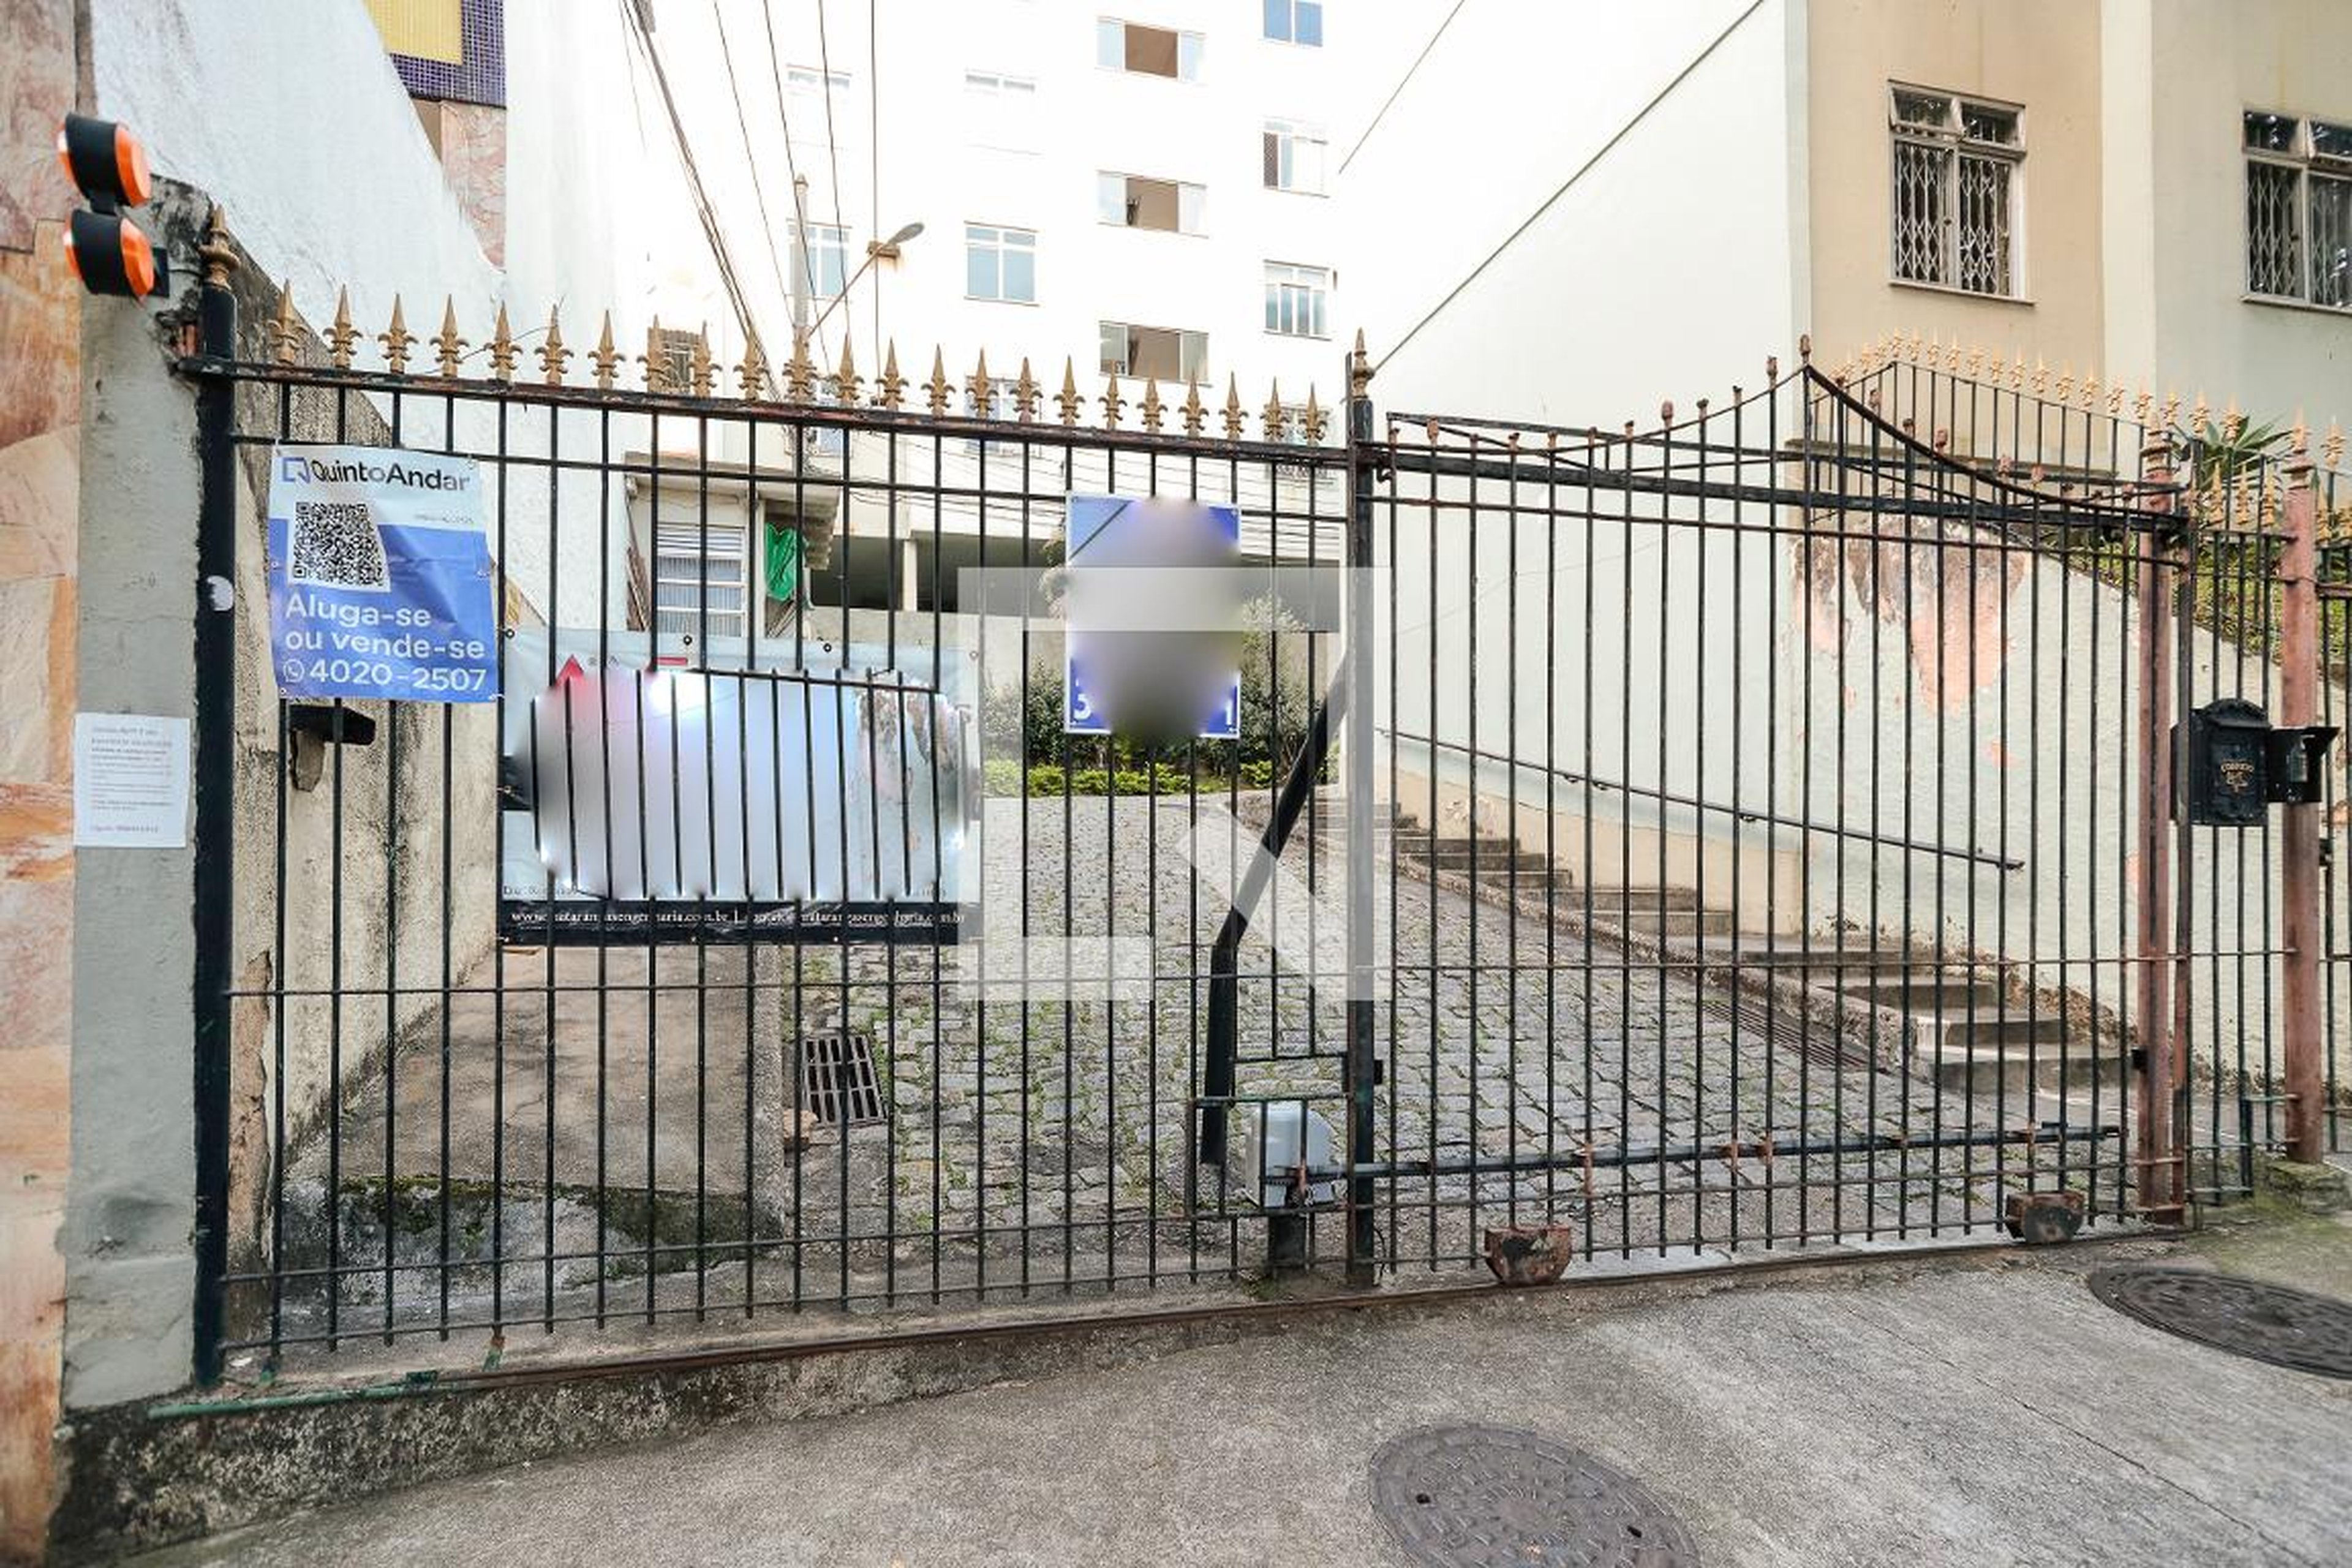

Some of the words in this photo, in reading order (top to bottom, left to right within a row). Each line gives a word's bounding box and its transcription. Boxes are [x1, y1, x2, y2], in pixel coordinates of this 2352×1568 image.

[311, 459, 470, 491] QuintoAndar
[286, 593, 430, 627] Aluga-se
[285, 631, 322, 650] ou
[331, 633, 486, 659] vende-se
[309, 659, 487, 692] 4020-2507
